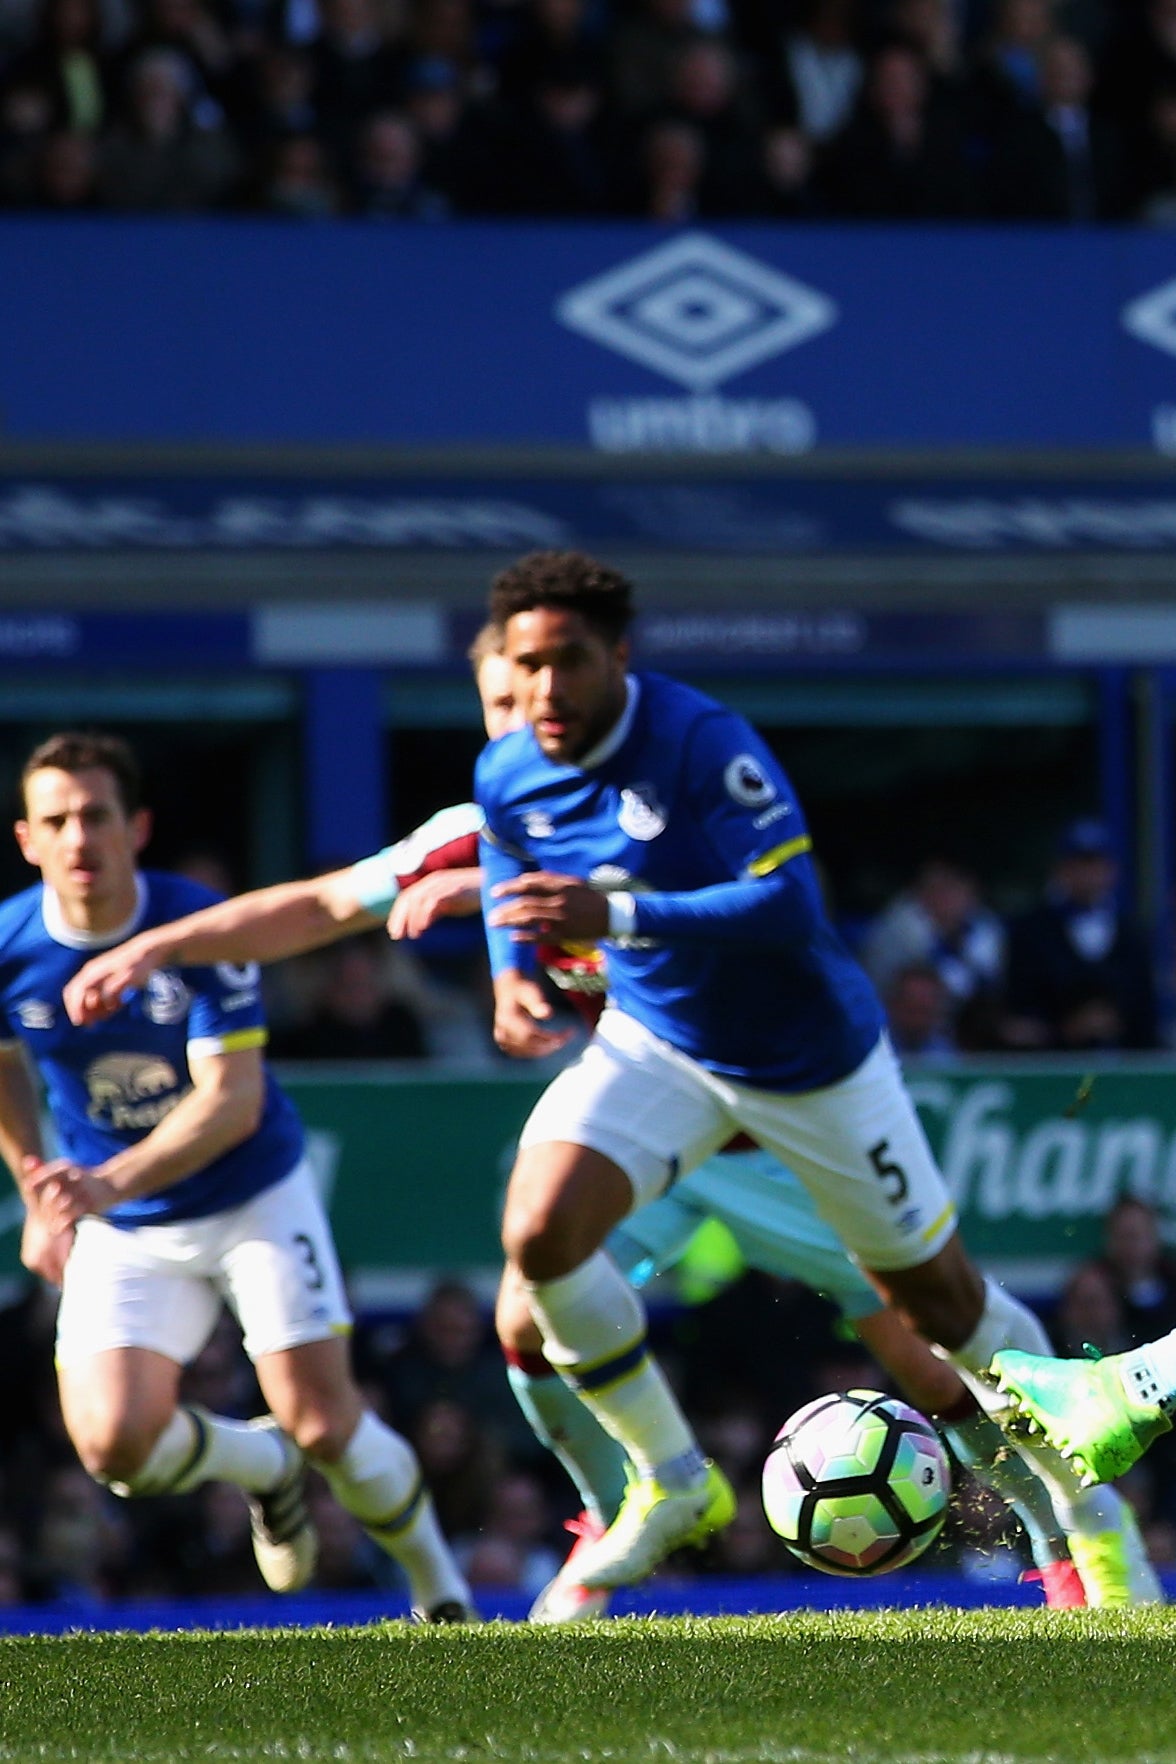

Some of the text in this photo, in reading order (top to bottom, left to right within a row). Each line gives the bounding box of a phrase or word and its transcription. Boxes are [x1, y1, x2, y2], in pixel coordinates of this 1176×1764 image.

[588, 398, 815, 455] umbro
[866, 1137, 910, 1208] 5
[293, 1232, 325, 1293] 3
